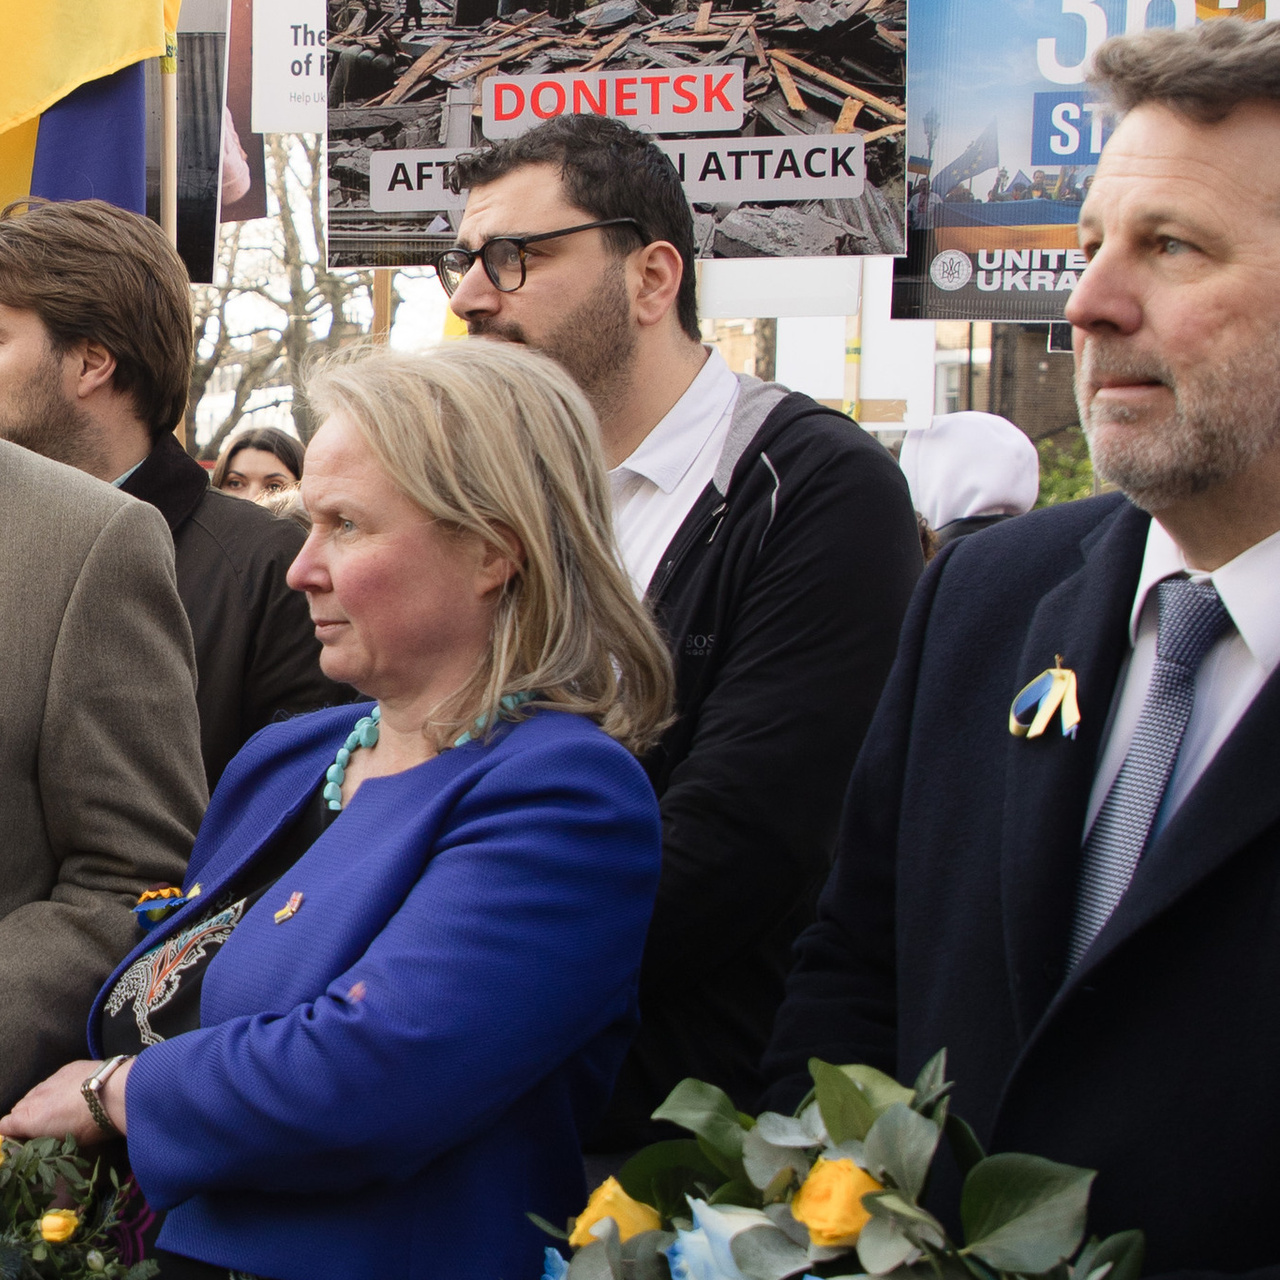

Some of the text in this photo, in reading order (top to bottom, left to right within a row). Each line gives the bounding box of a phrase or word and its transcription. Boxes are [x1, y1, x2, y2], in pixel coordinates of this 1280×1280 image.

[290, 24, 326, 46] The
[291, 53, 313, 76] of
[289, 91, 325, 105] Help Uk
[493, 72, 735, 121] DONETSK
[698, 146, 856, 182] ATTACK
[977, 248, 1088, 269] UNITE
[976, 271, 1079, 291] UKRA
